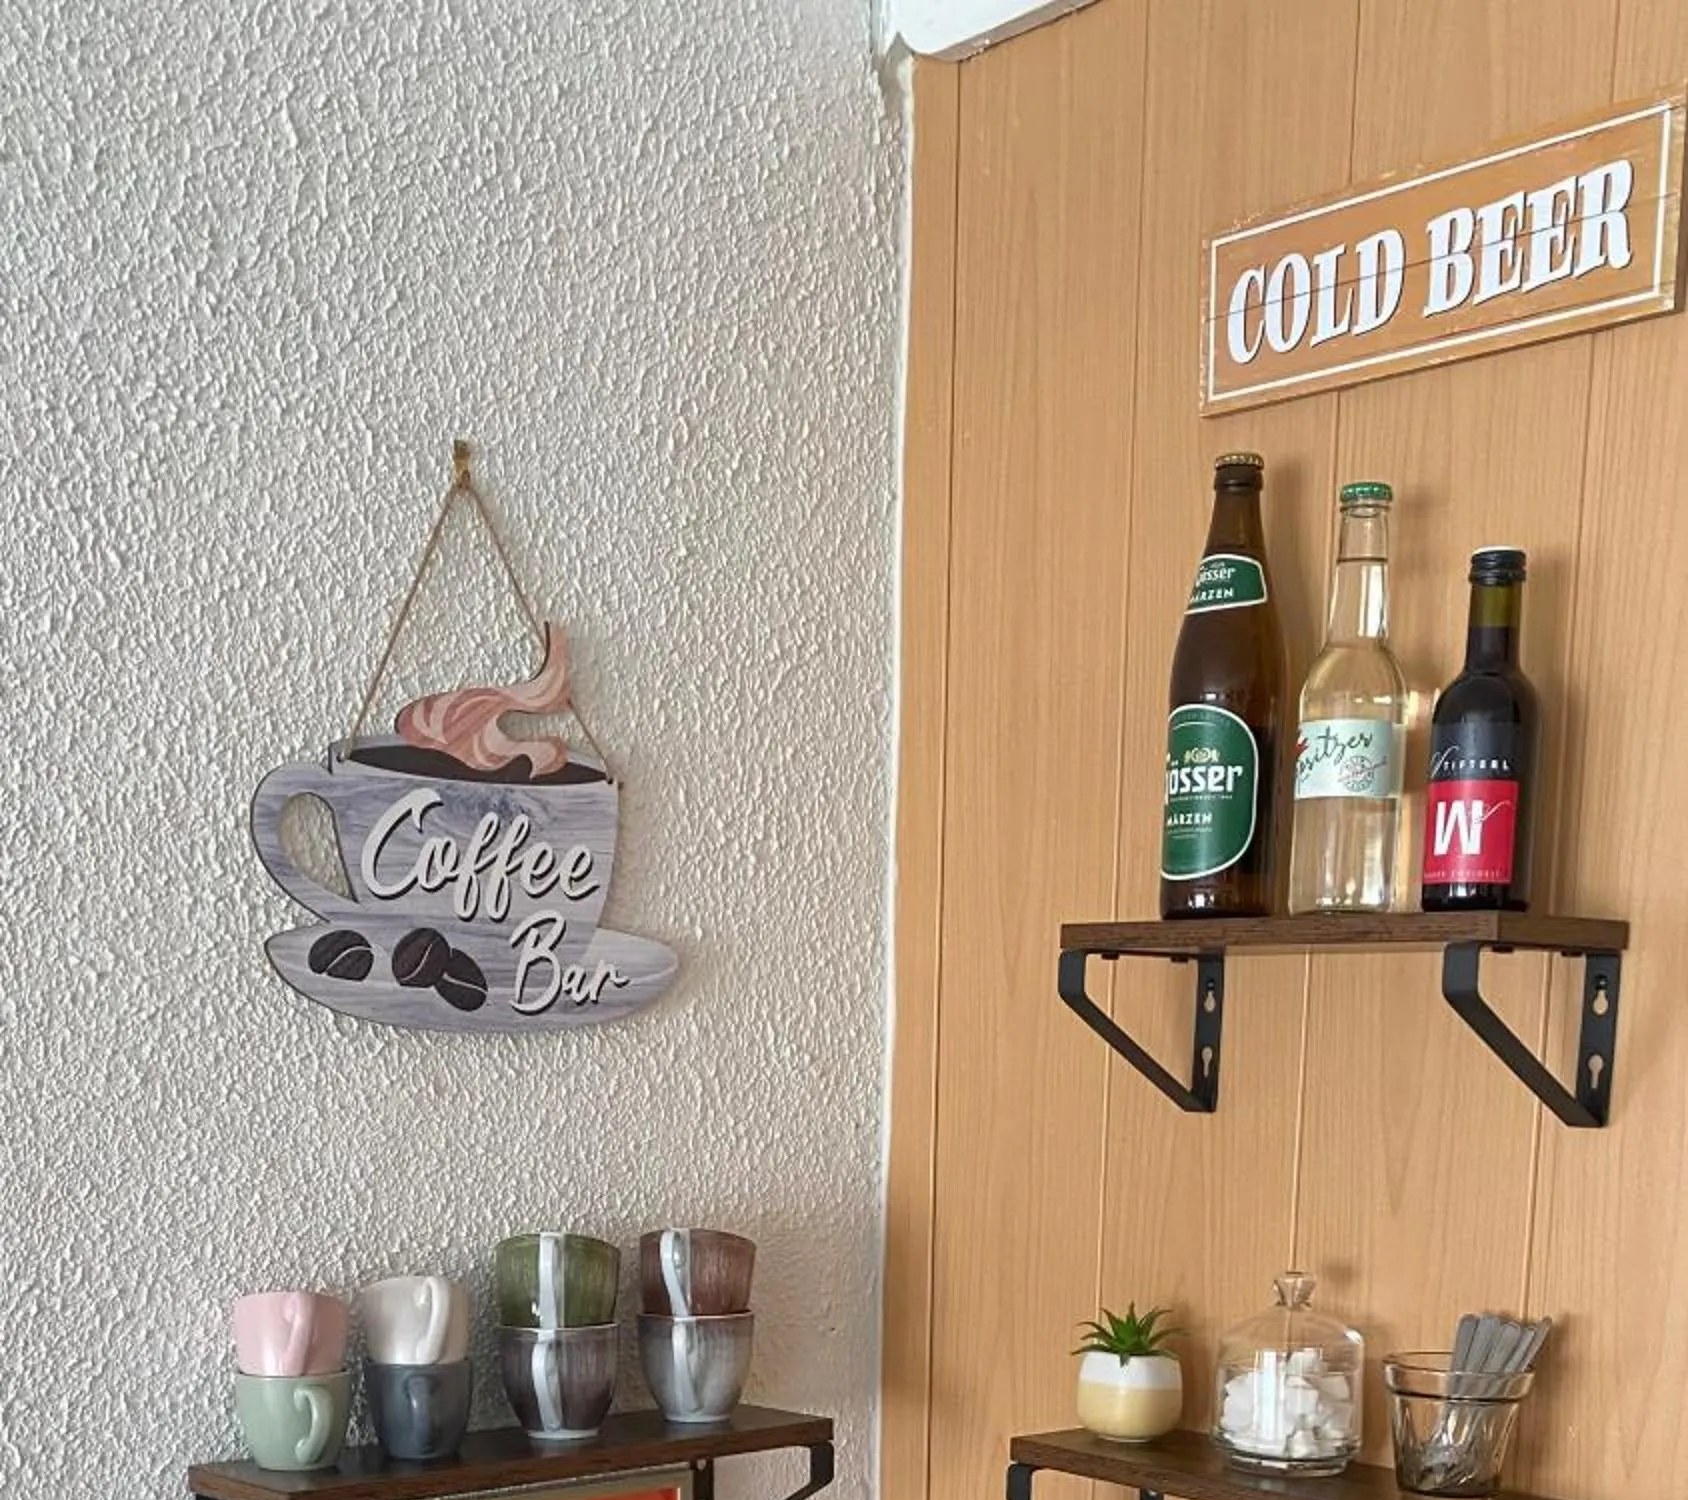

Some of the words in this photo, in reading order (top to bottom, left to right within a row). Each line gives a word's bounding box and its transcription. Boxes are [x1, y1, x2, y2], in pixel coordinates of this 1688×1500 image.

[1226, 229, 1405, 364] COLD
[1423, 160, 1634, 317] BEER
[1166, 758, 1243, 798] össer
[361, 787, 600, 922] Coffee
[510, 909, 631, 1016] Bar
